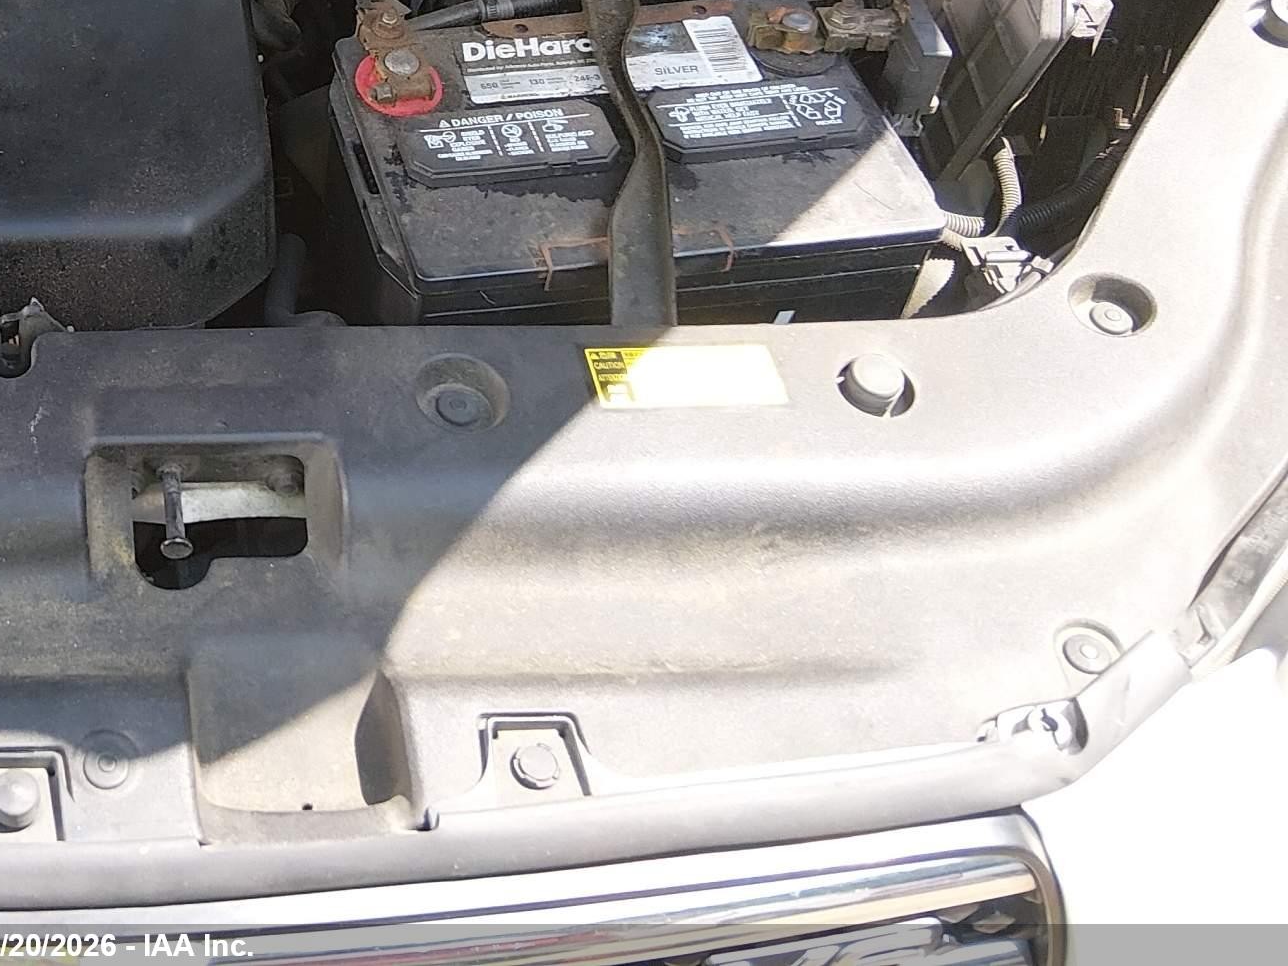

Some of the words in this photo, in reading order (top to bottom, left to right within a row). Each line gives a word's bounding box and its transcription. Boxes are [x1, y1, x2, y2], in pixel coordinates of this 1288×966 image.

[654, 65, 700, 75] SILVER
[451, 114, 505, 127] DANGER
[515, 109, 564, 121] POISON
[593, 361, 625, 370] CAUTION
